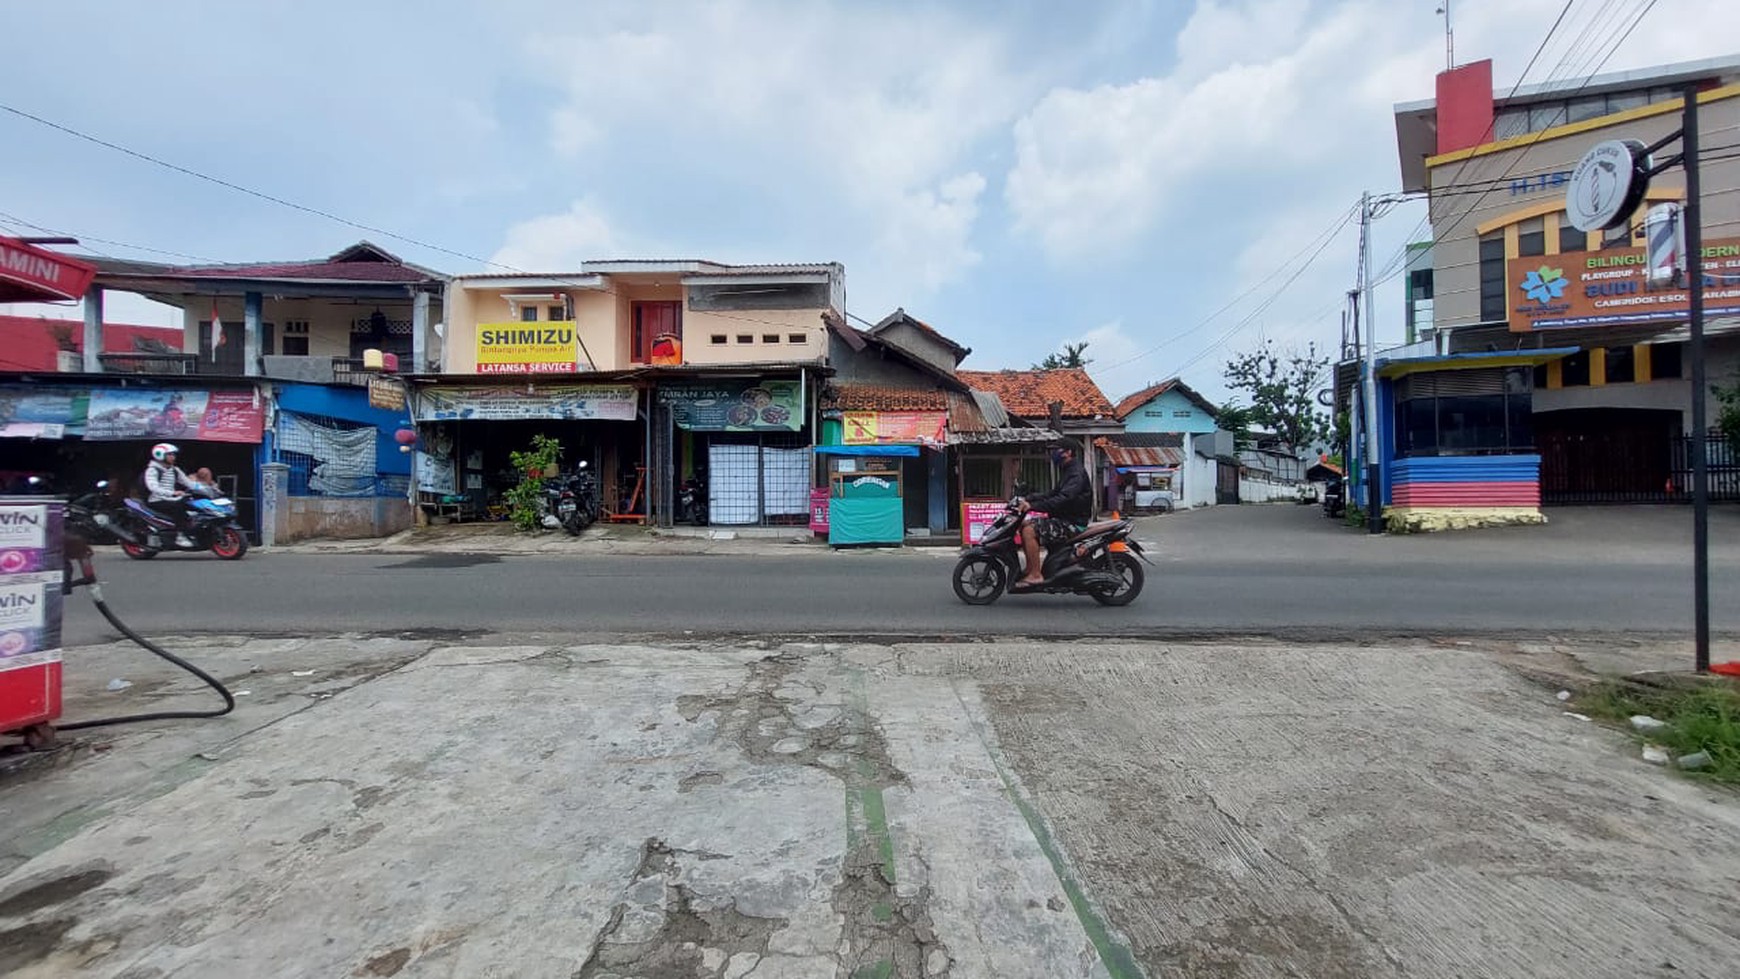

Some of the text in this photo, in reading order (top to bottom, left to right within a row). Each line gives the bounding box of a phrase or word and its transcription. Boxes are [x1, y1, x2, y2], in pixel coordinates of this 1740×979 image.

[1586, 254, 1647, 269] BILINGU
[481, 329, 572, 345] SHIMIZU
[481, 362, 573, 373] LATANSA SERVICE
